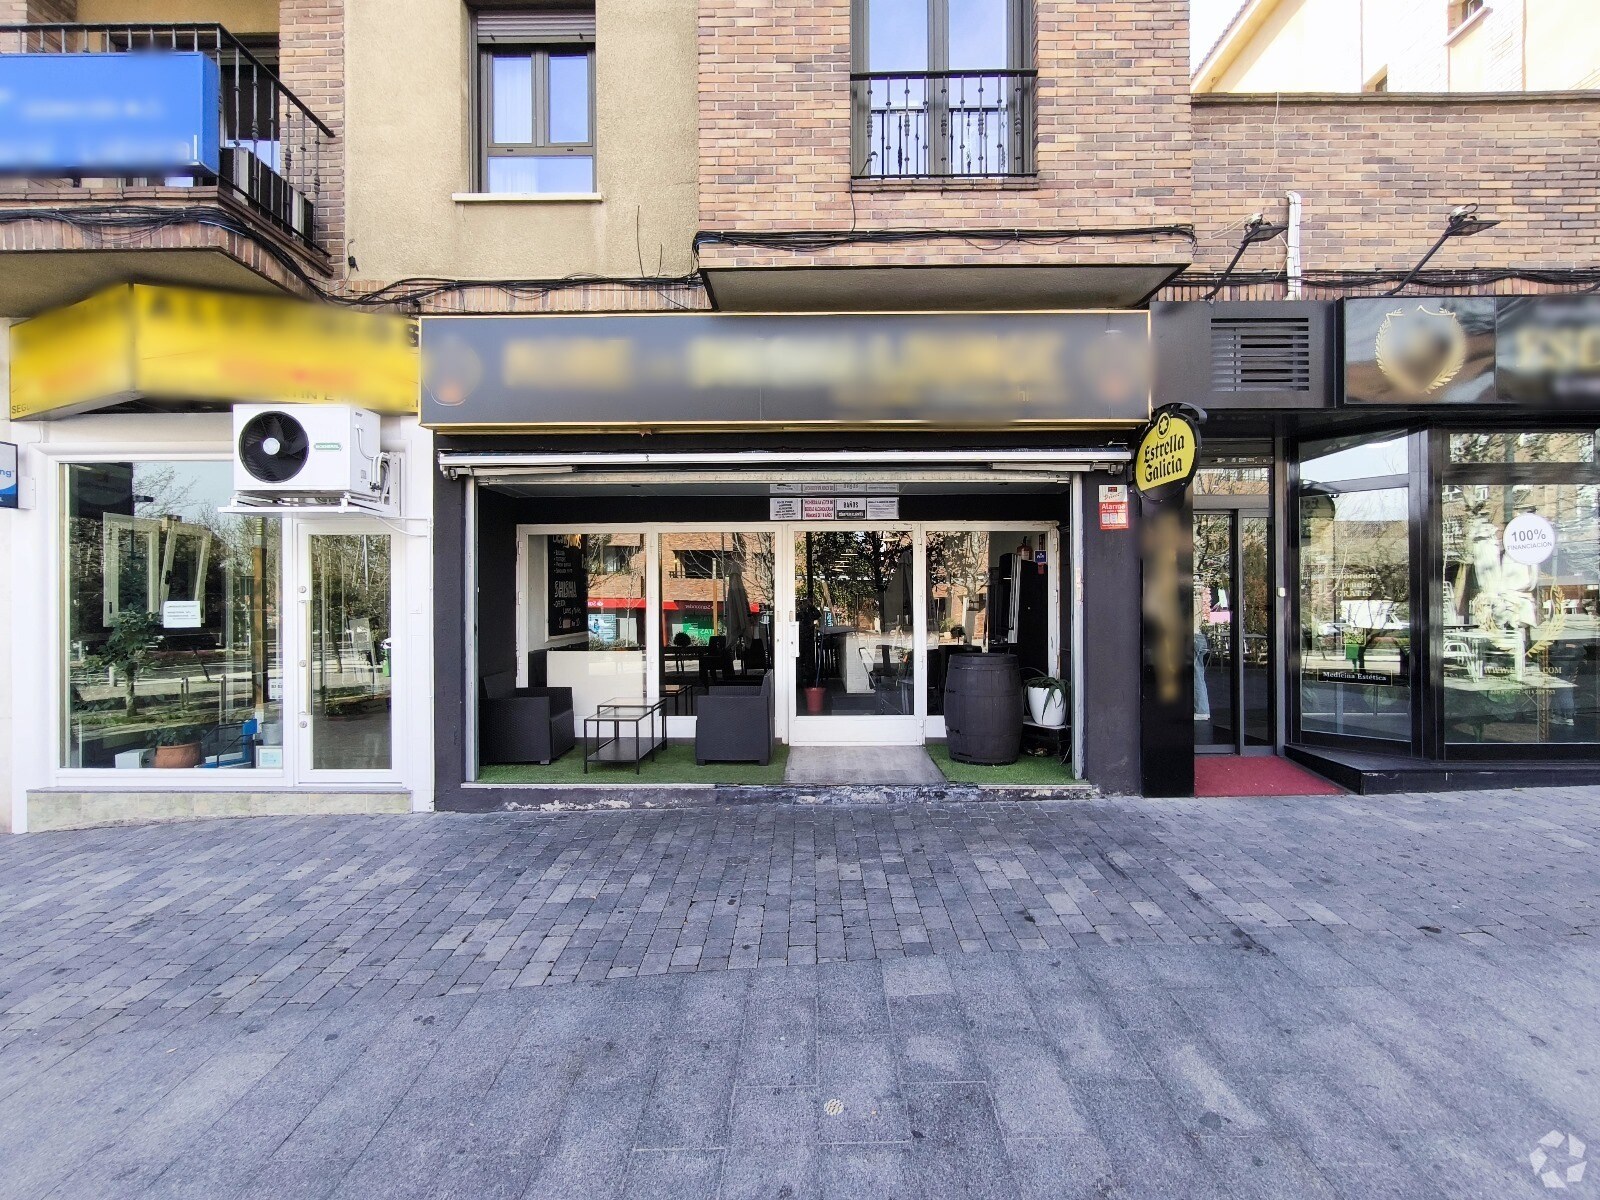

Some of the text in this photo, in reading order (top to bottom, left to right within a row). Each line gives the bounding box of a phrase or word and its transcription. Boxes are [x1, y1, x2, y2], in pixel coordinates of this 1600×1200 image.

[1144, 433, 1185, 464] Estrella
[1145, 455, 1183, 483] Galicia
[1511, 529, 1547, 542] 100%
[1322, 671, 1387, 681] Medicina Estética
